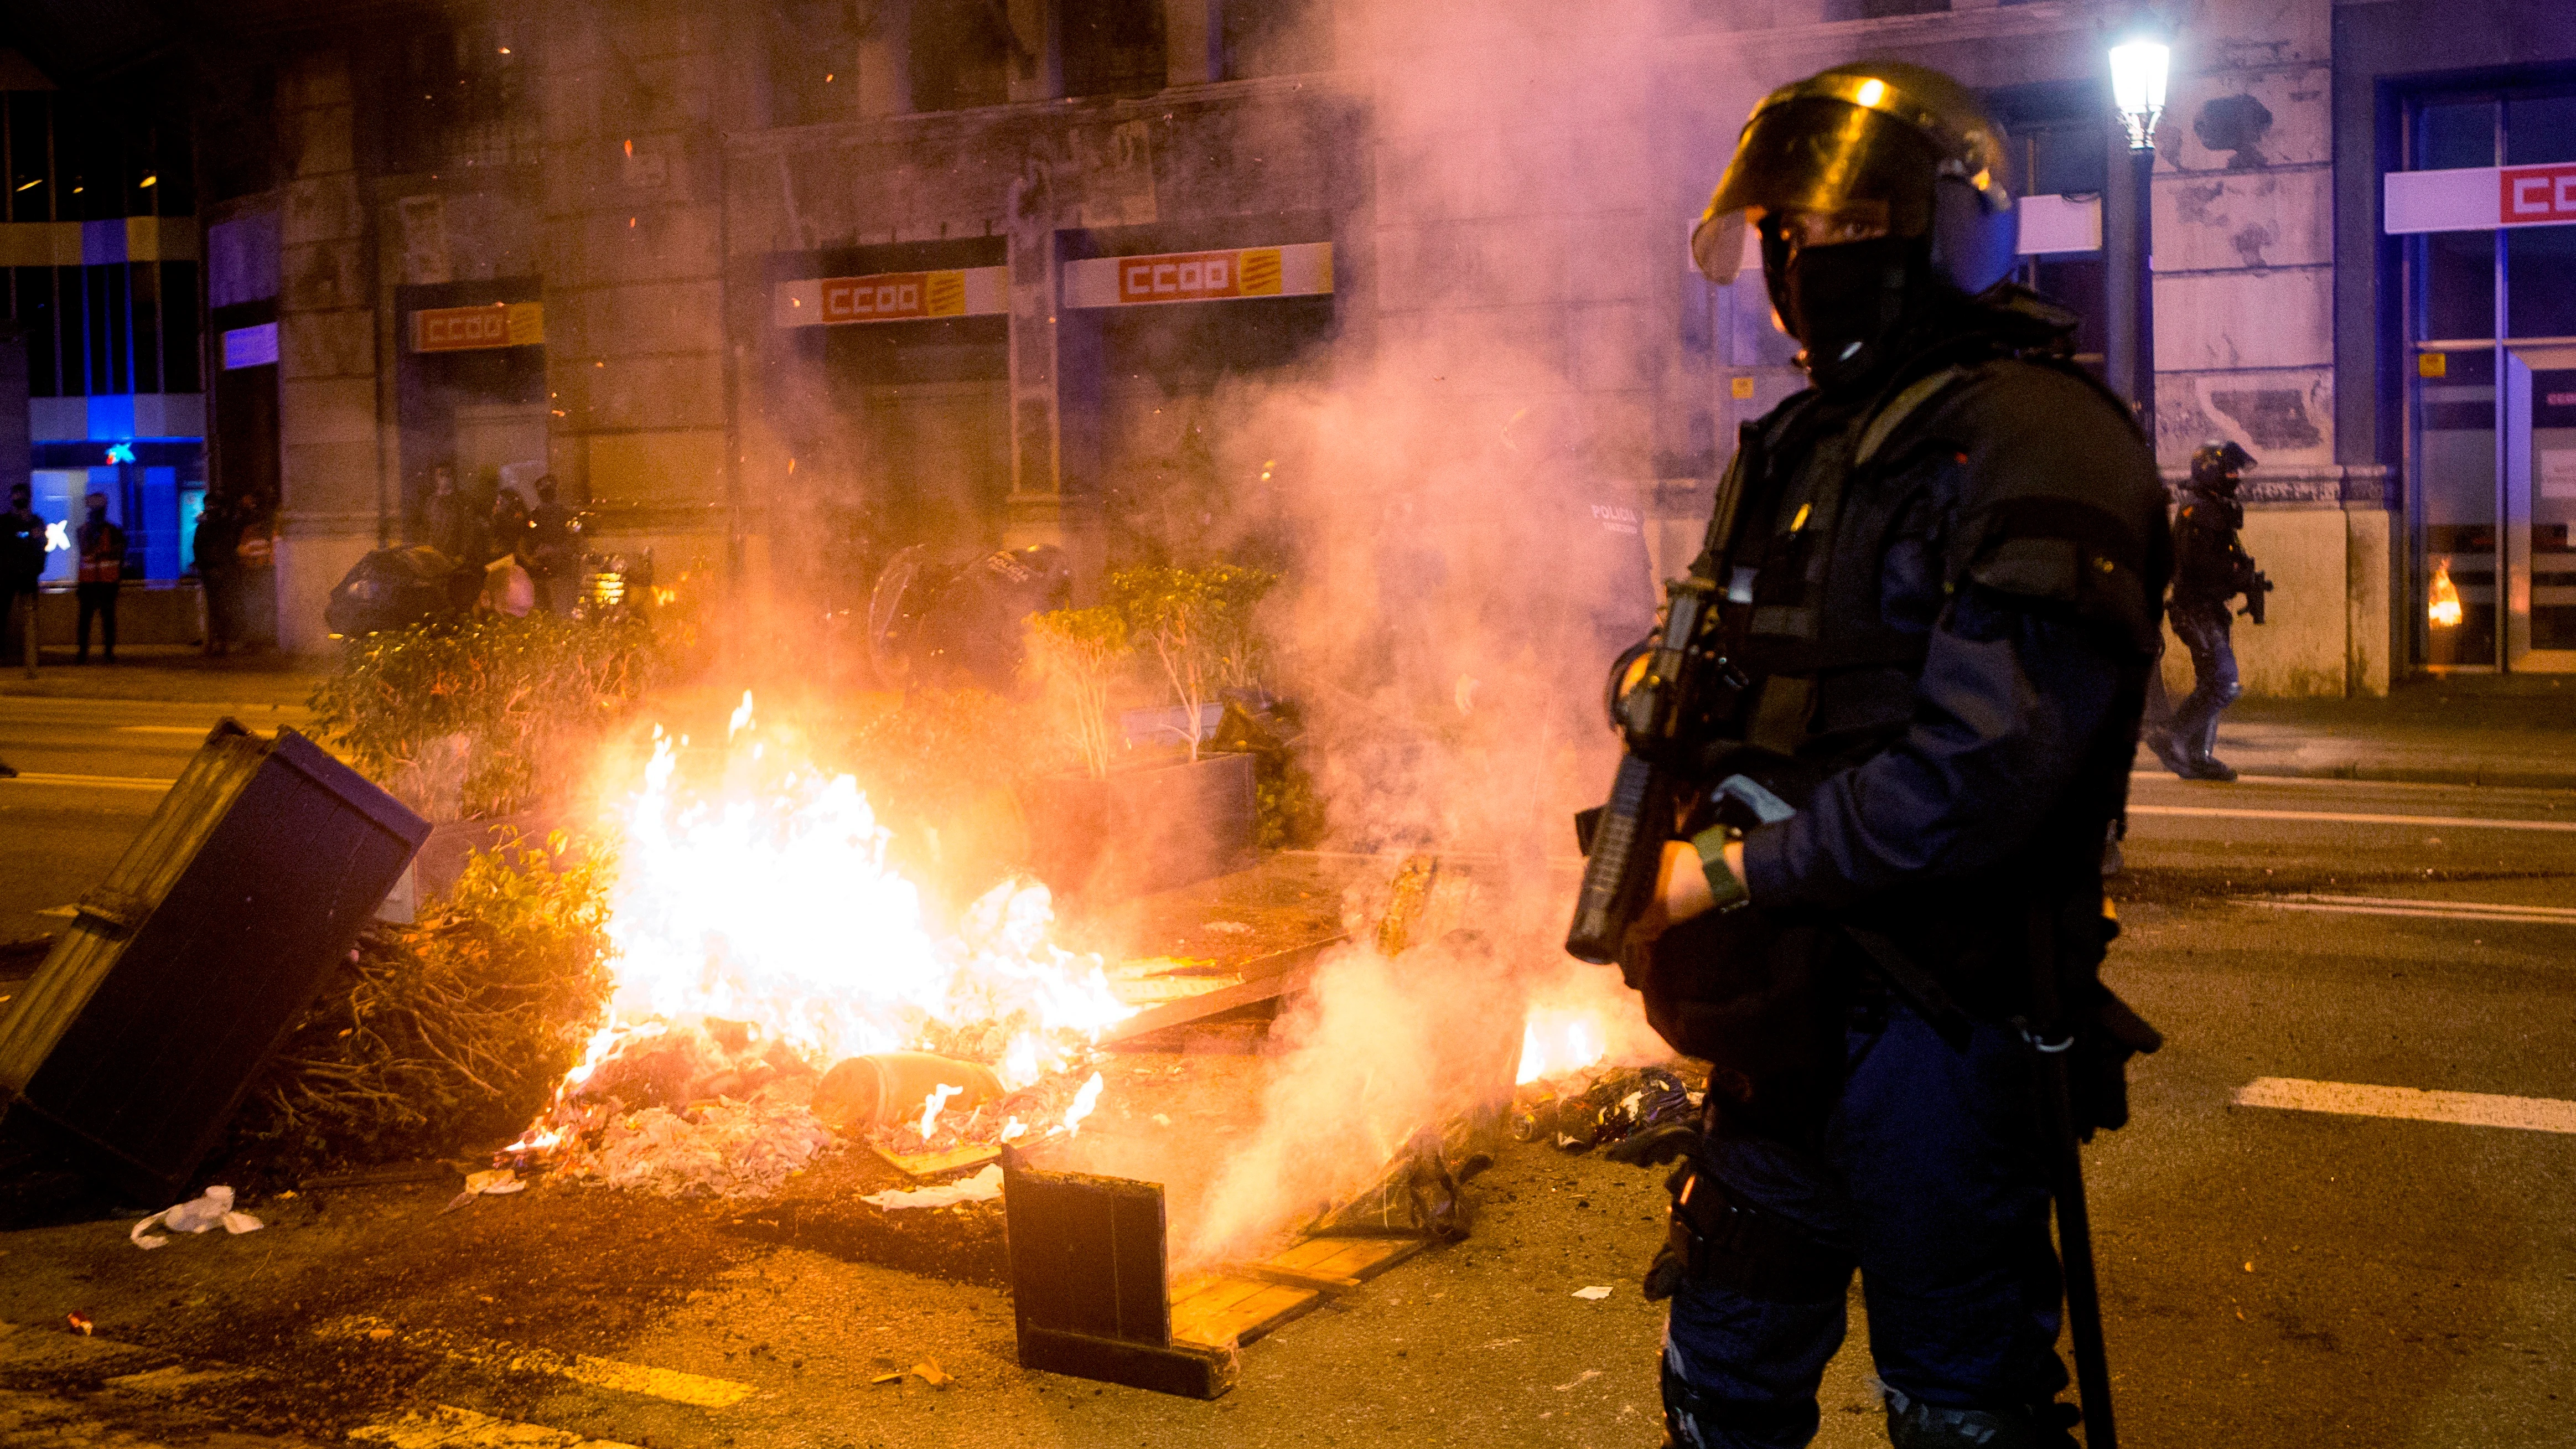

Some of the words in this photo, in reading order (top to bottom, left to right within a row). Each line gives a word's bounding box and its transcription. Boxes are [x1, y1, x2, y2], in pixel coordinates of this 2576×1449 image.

[1127, 260, 1229, 294] CCOO
[830, 284, 919, 315] CCOO
[429, 314, 504, 342] CCOO
